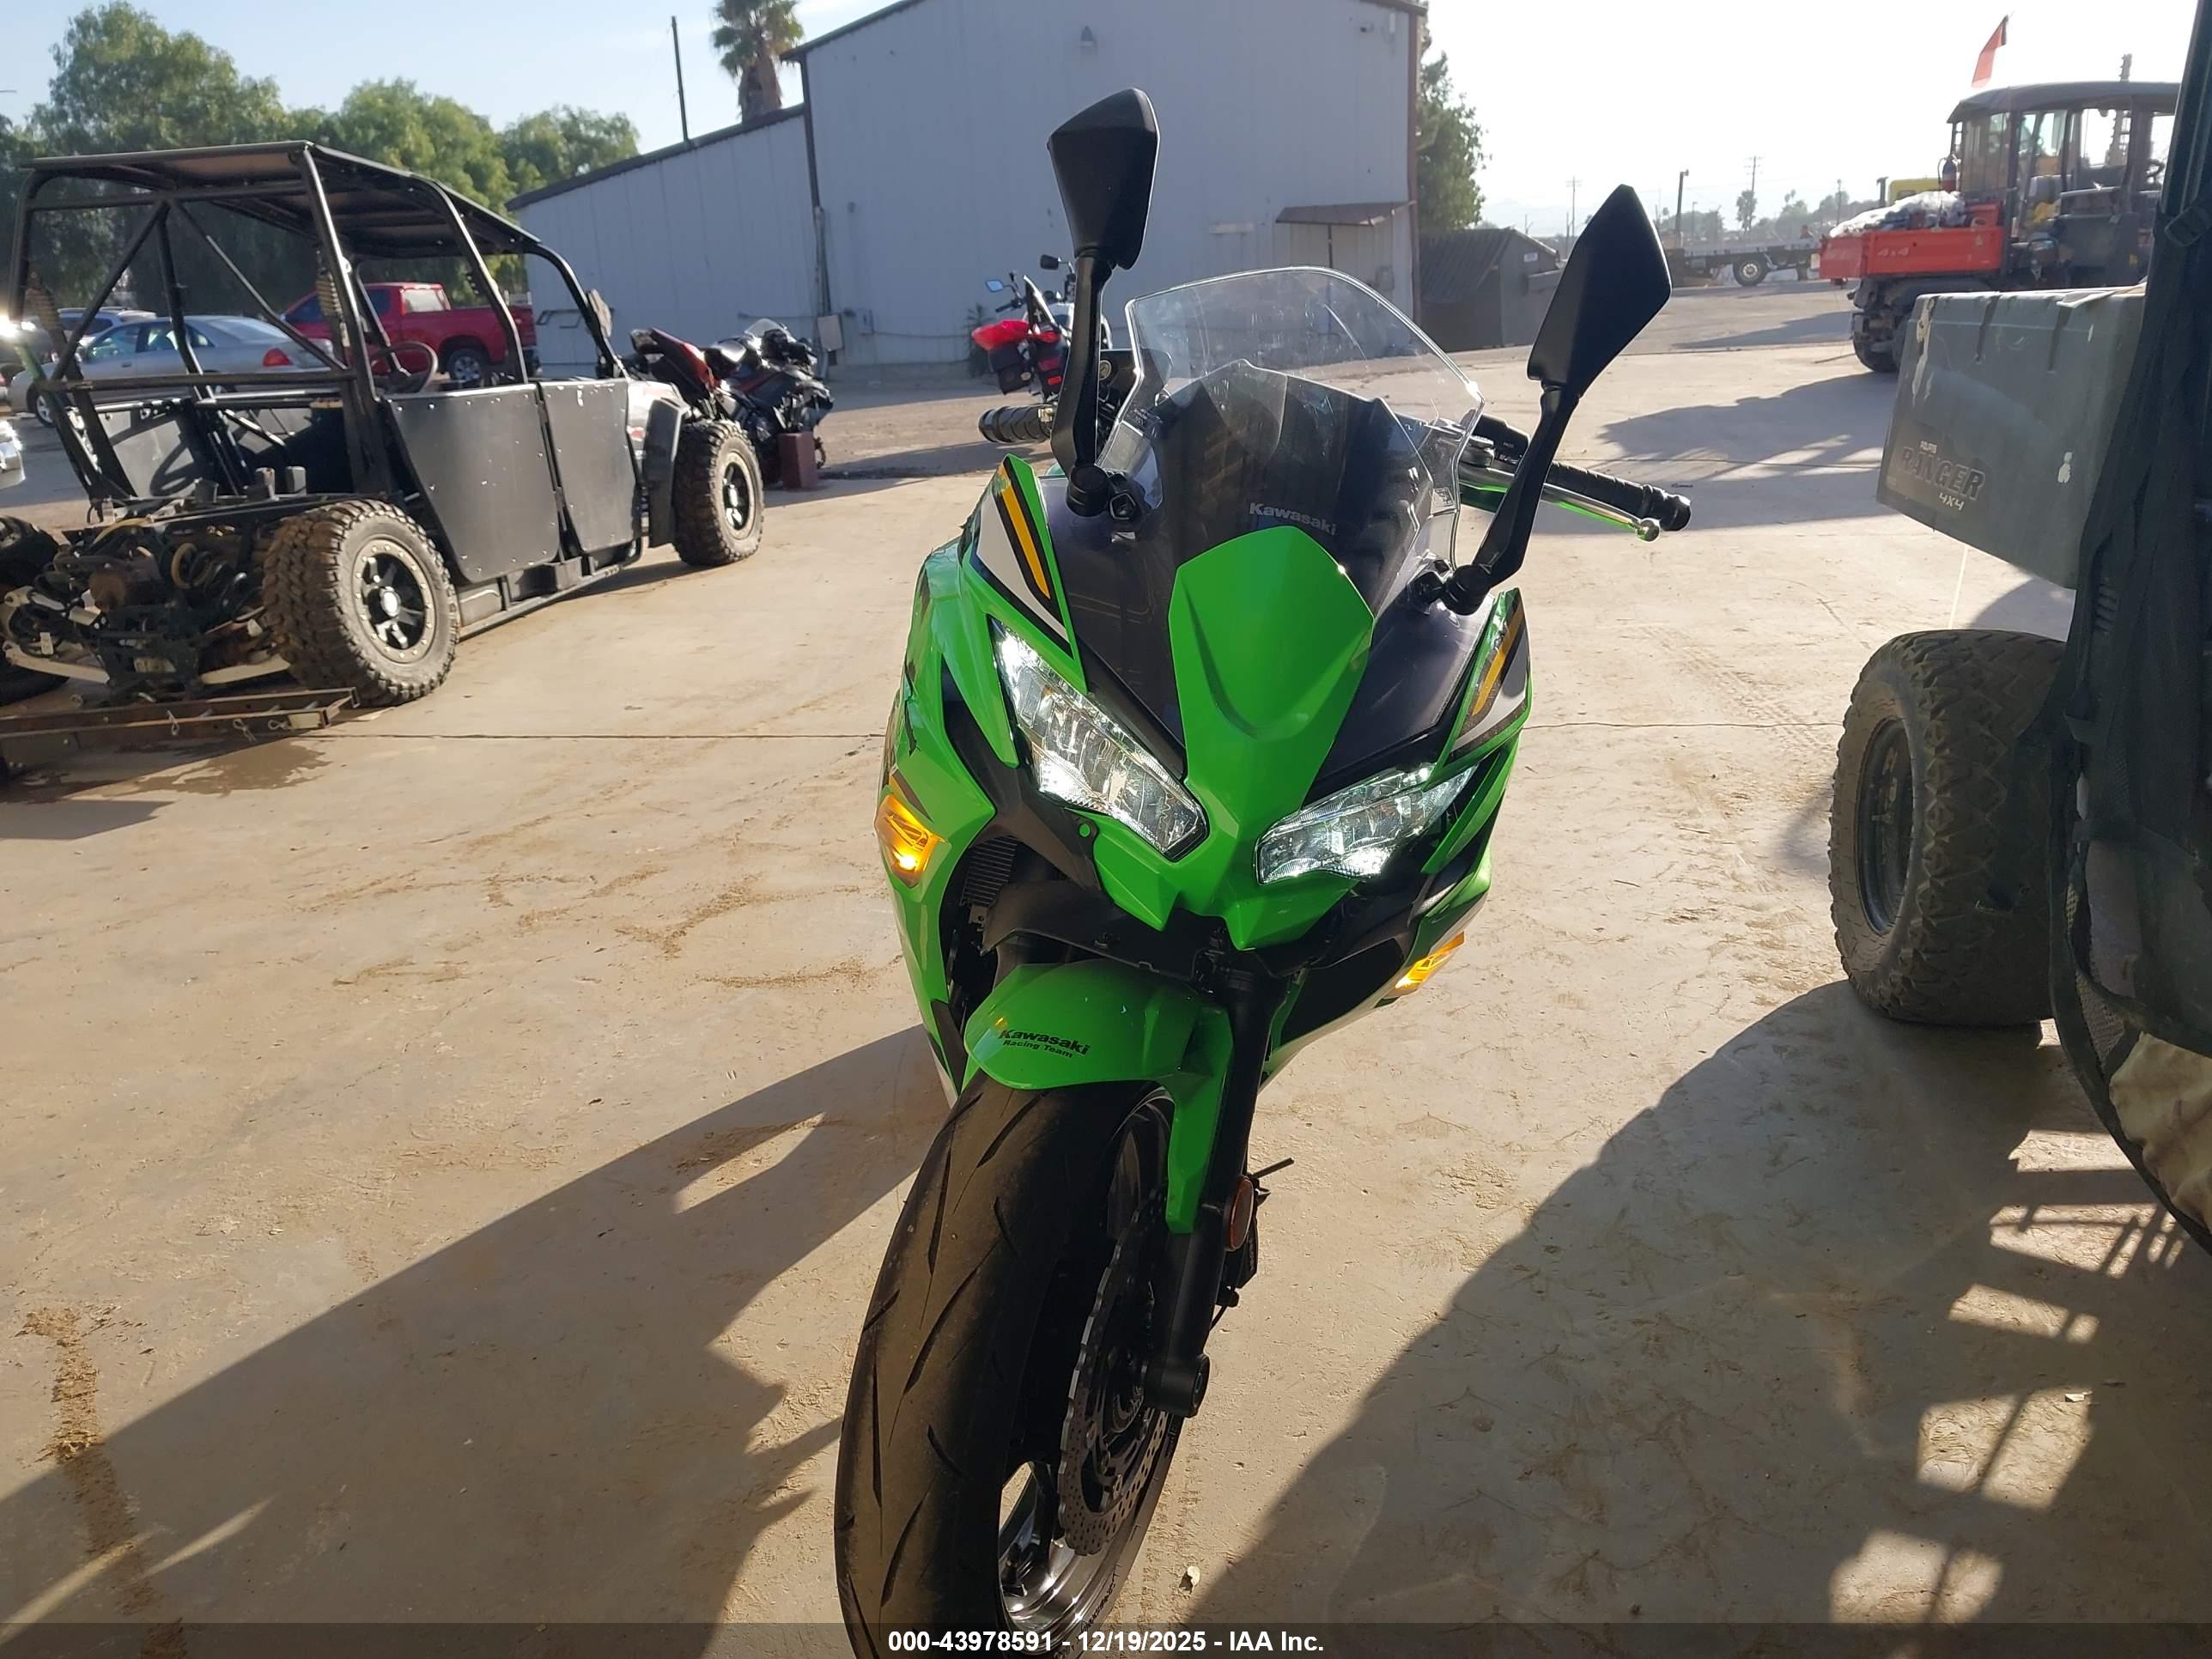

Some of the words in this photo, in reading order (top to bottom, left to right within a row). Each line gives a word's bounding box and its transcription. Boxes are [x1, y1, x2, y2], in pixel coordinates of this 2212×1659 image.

[1902, 446, 1986, 501] RANGER
[1249, 502, 1337, 536] Kawasaki
[998, 1029, 1091, 1055] Kawasaki
[1002, 1039, 1041, 1050] Racing
[1043, 1044, 1073, 1058] Team
